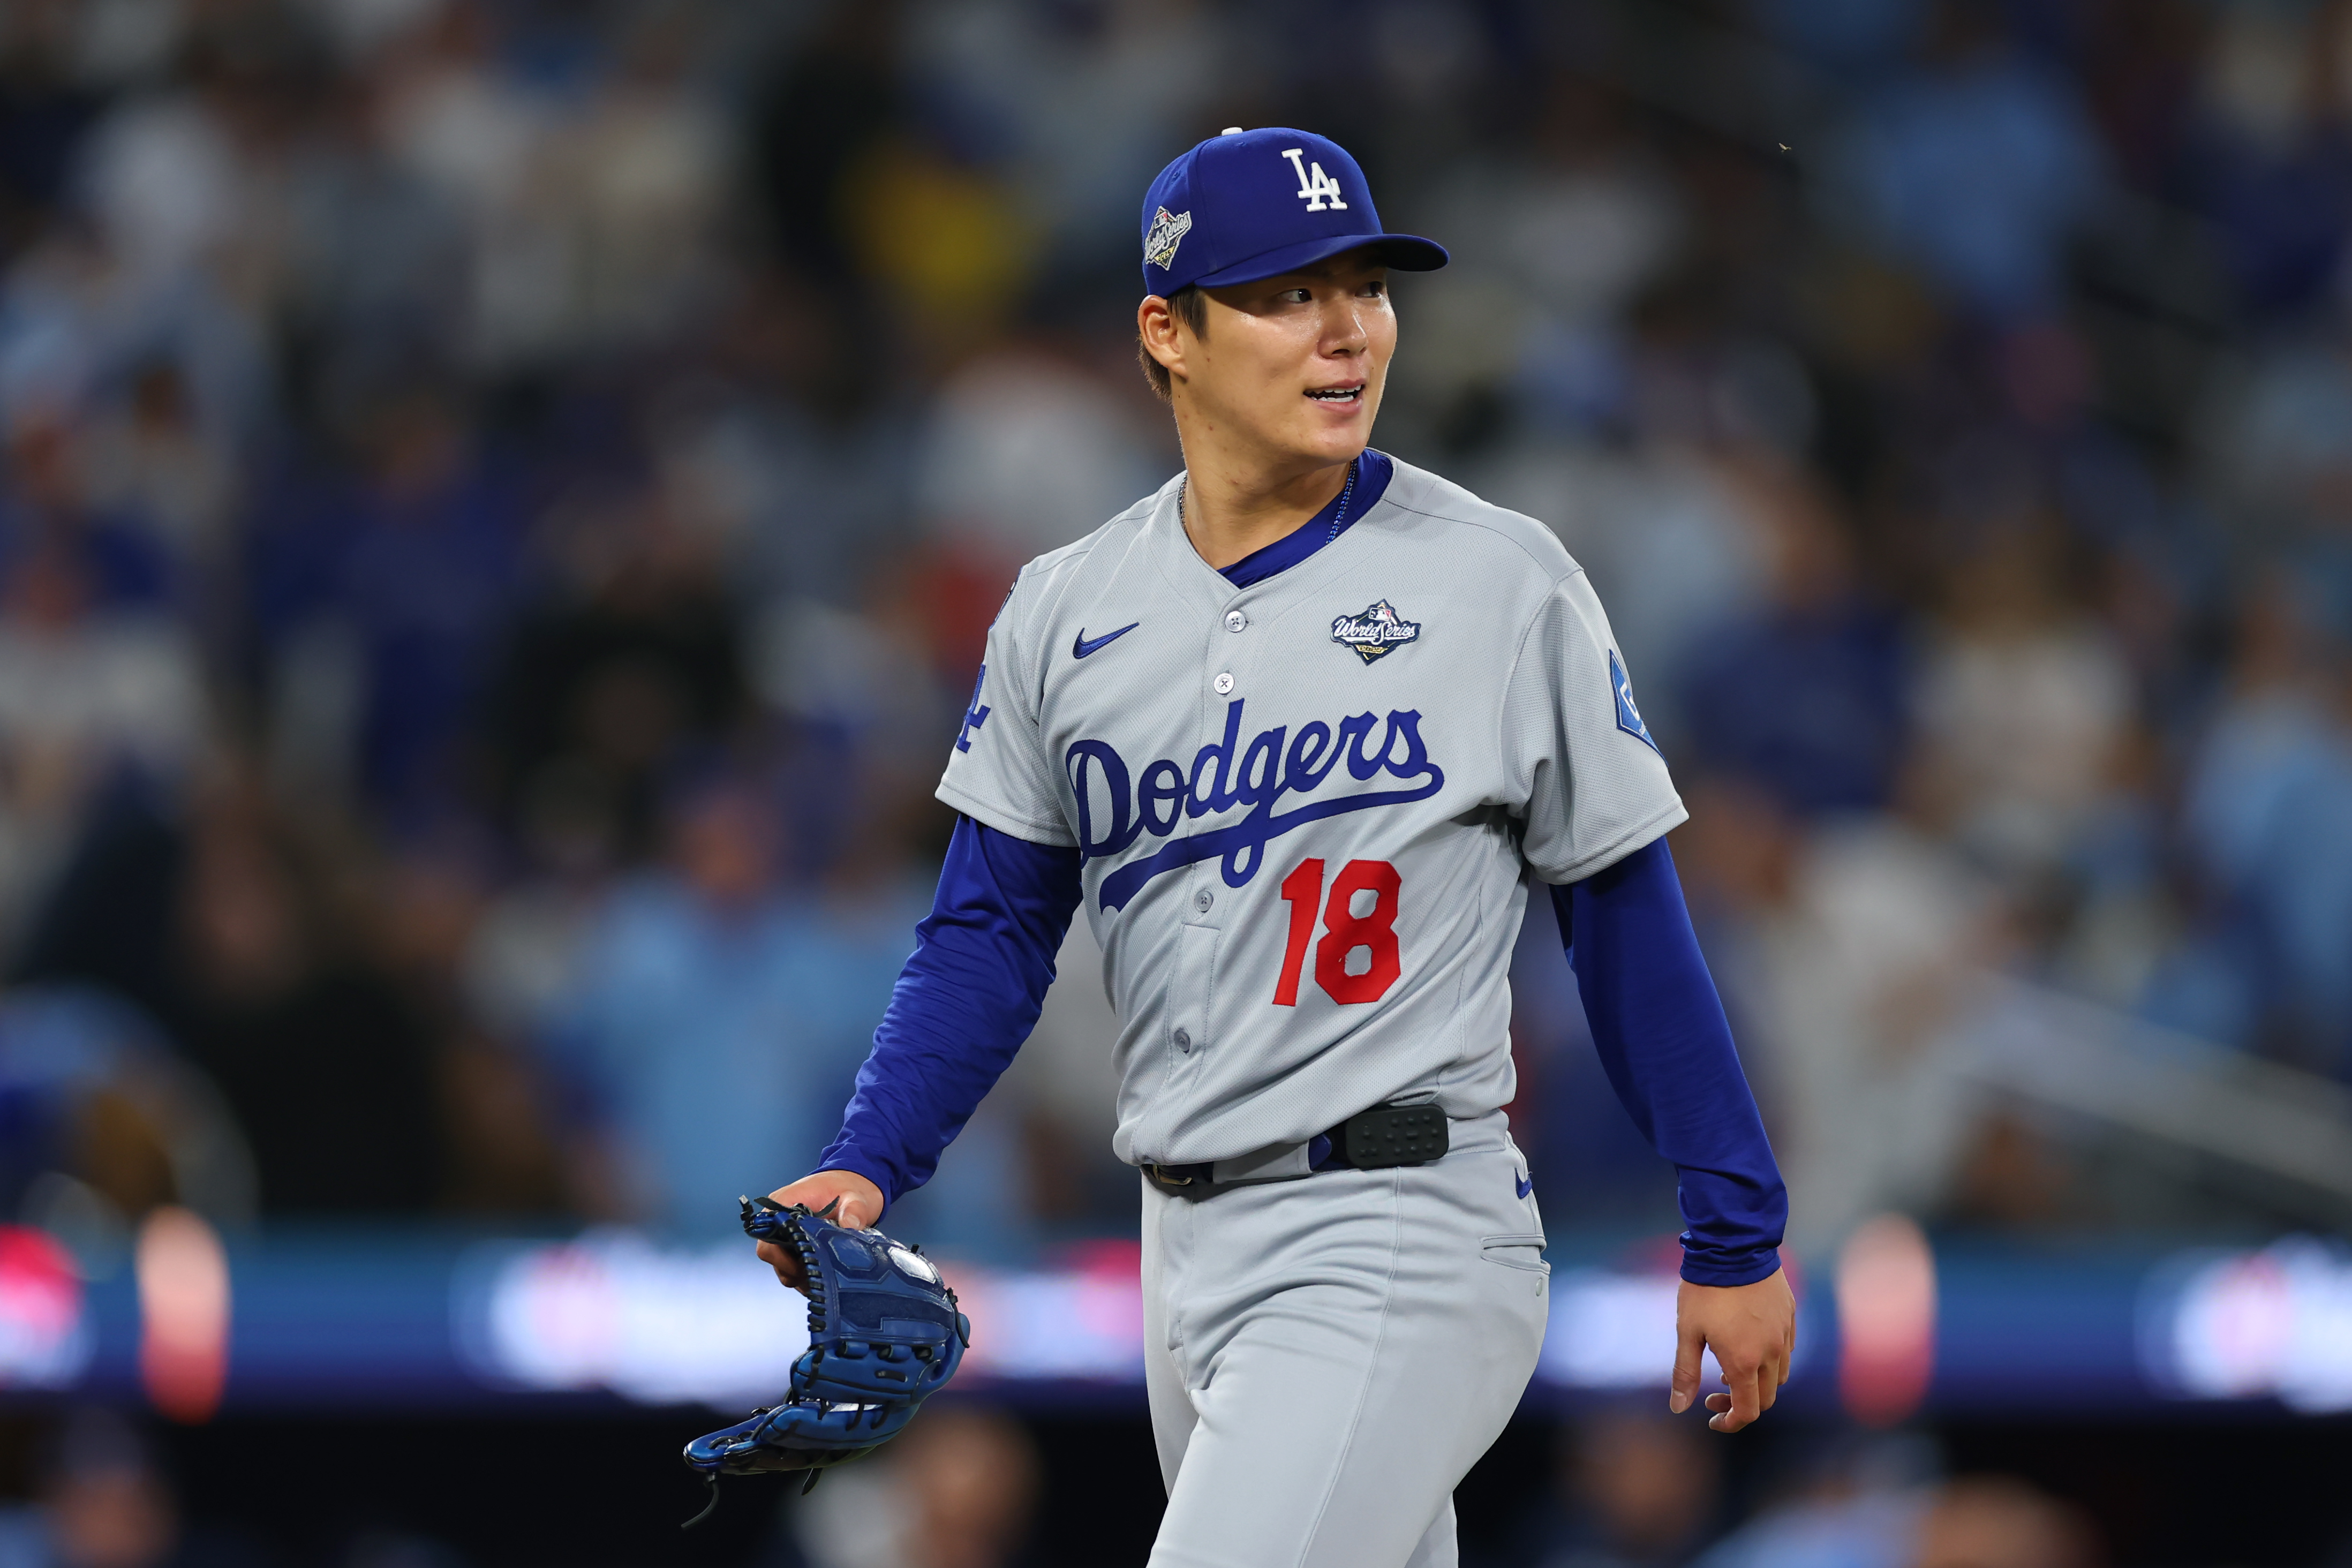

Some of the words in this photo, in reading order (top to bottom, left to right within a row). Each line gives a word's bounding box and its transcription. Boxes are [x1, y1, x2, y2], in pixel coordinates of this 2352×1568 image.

[1281, 148, 1348, 213] LA
[1158, 250, 1172, 262] 2025
[1162, 214, 1189, 249] Series
[1333, 618, 1381, 638] World
[1371, 621, 1415, 645] Series
[1065, 698, 1445, 915] Dodgers
[1272, 857, 1401, 1007] 18
